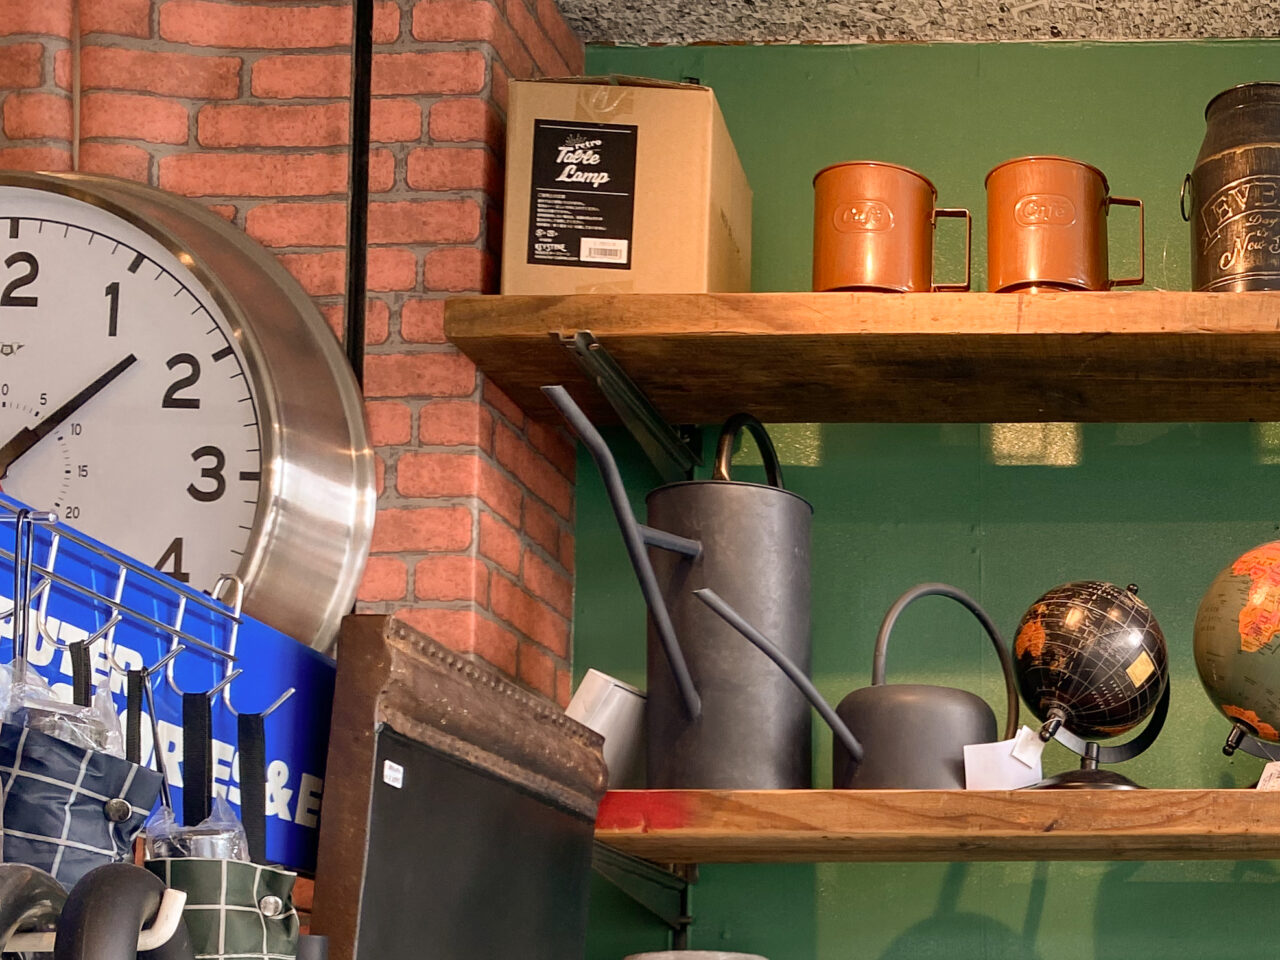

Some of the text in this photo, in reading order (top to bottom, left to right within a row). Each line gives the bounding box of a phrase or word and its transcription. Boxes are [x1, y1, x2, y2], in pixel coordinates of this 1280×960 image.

[555, 146, 600, 164] Table
[555, 164, 610, 188] Lamp
[105, 281, 120, 337] 1
[162, 353, 201, 408] 2
[39, 392, 48, 406] 5
[70, 423, 82, 436] 10
[78, 465, 89, 477] 15
[187, 445, 226, 502] 3
[65, 506, 80, 519] 20
[154, 537, 190, 583] 4
